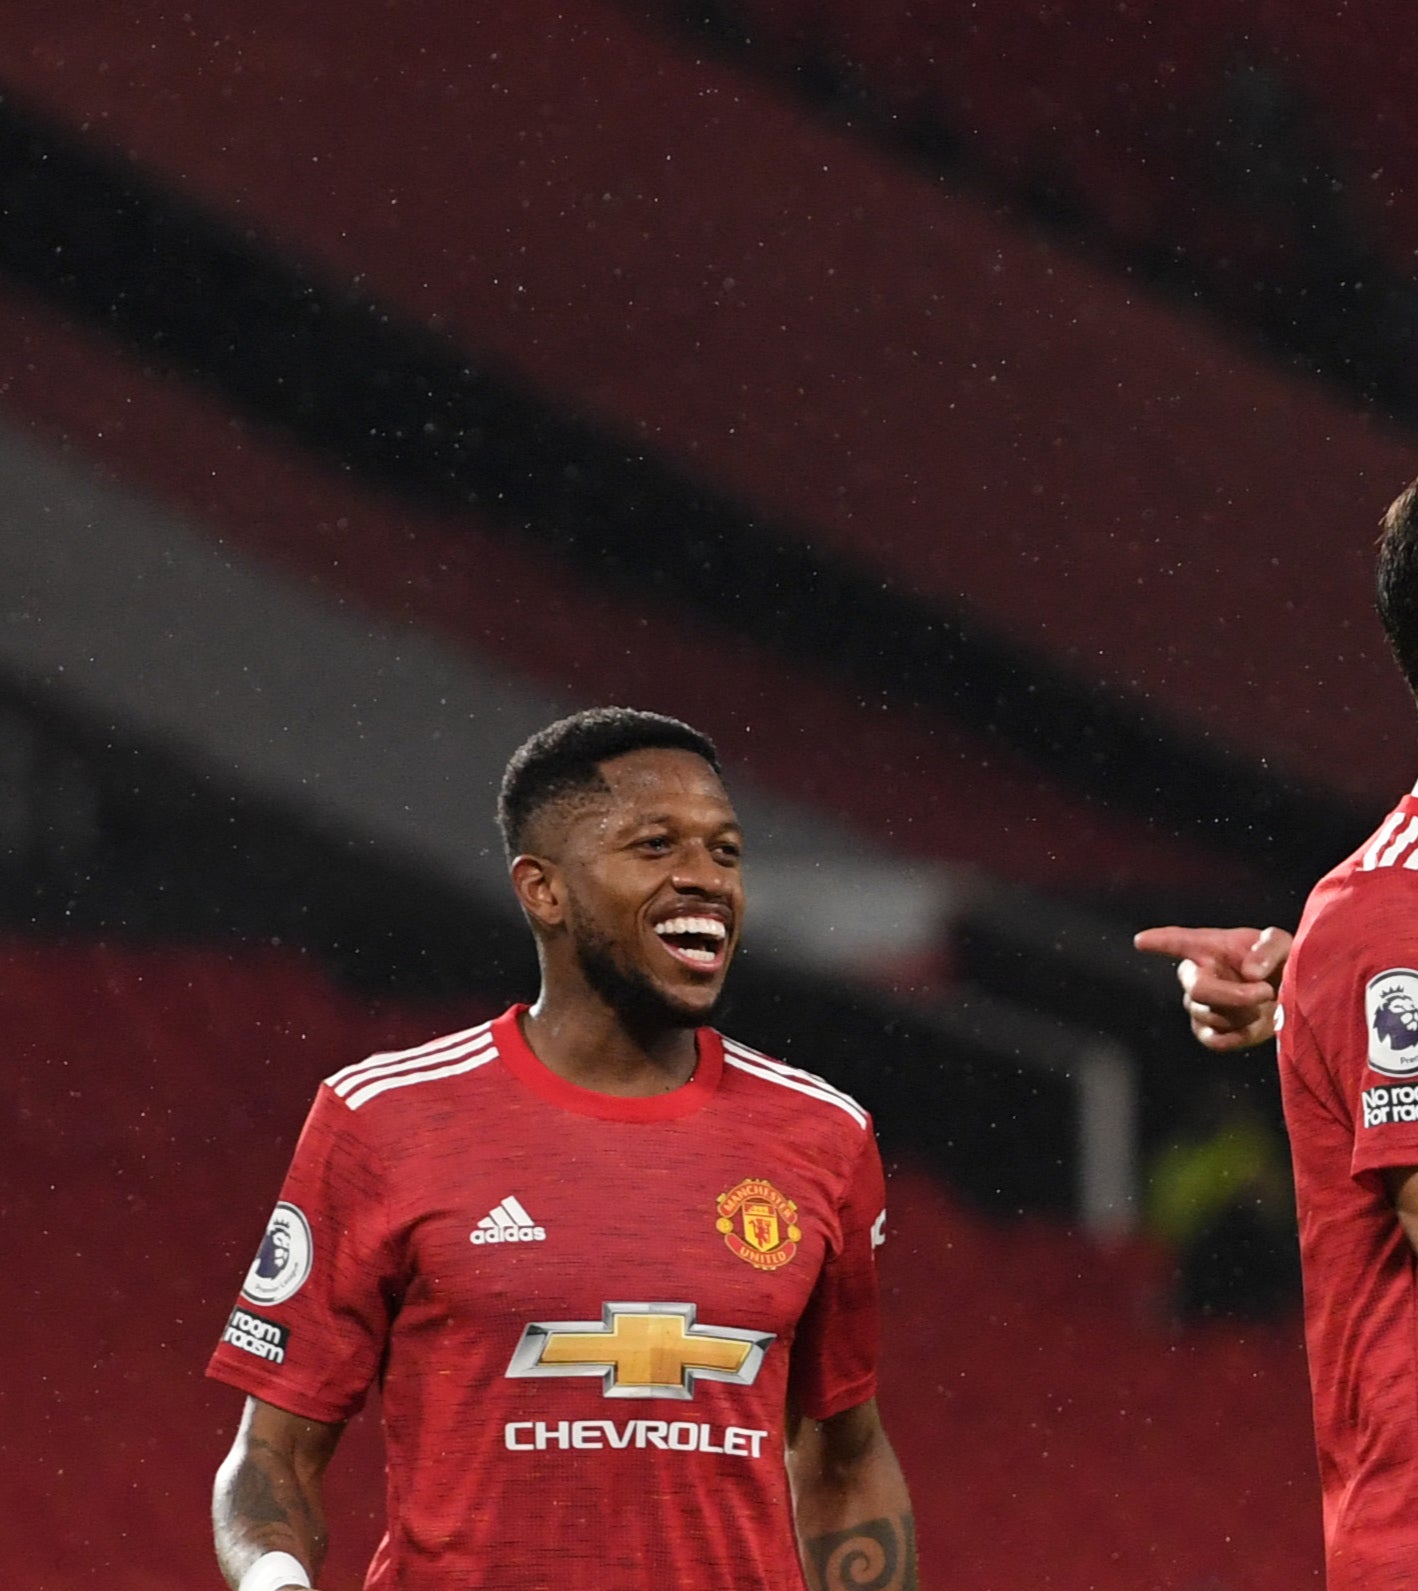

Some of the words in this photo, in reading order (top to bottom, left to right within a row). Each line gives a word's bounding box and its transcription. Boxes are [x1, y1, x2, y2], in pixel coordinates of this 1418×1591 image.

[1362, 1087, 1389, 1109] No
[470, 1225, 546, 1245] adidas
[740, 1246, 786, 1264] UNITED
[232, 1310, 281, 1344] room
[504, 1419, 769, 1458] CHEVROLET
